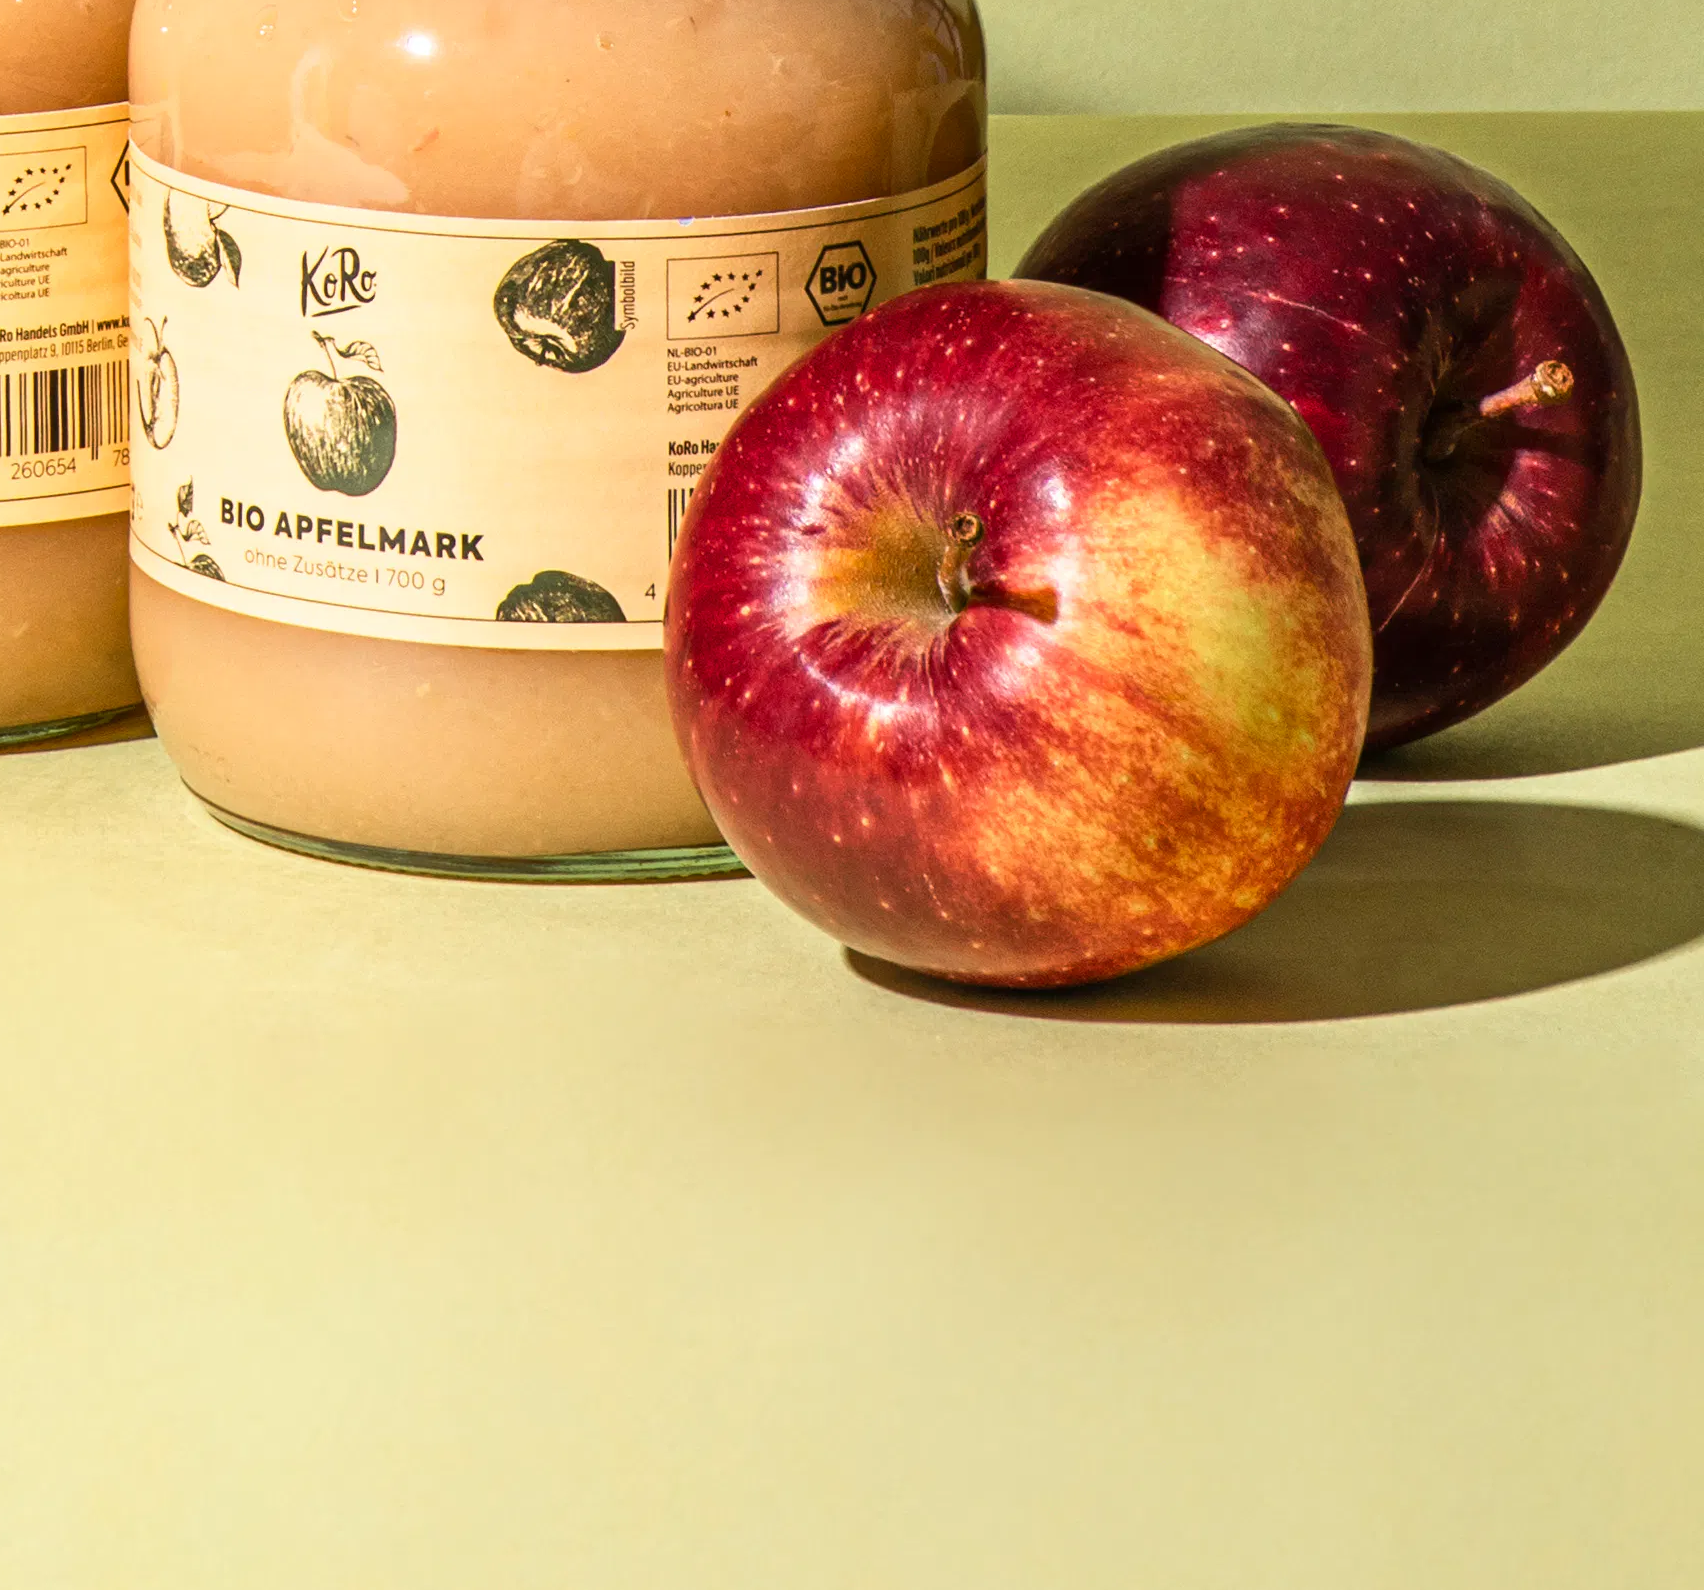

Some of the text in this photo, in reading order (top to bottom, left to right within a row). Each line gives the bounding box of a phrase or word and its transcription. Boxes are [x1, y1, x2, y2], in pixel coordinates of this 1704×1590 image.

[38, 275, 50, 285] UE
[301, 245, 377, 317] KoRo
[38, 288, 50, 298] UE
[620, 260, 639, 330] Symbolbild
[16, 325, 58, 341] Handels
[59, 320, 89, 337] GmbH
[50, 344, 59, 358] 9,
[61, 341, 84, 356] 10115
[86, 336, 115, 353] Berlin,
[667, 346, 717, 358] NL-BIO-01
[667, 356, 758, 372] EU-Landwirtschaft
[667, 373, 739, 388] EU-agriculture
[667, 386, 739, 401] Agriculture UE
[667, 399, 739, 415] Agricoltura UE
[668, 440, 699, 456] KoRo
[11, 457, 77, 480] 260654
[221, 497, 485, 562] BIO APFELMARK
[245, 546, 447, 597] ohne Zusätze 700 g
[644, 582, 656, 600] 4
